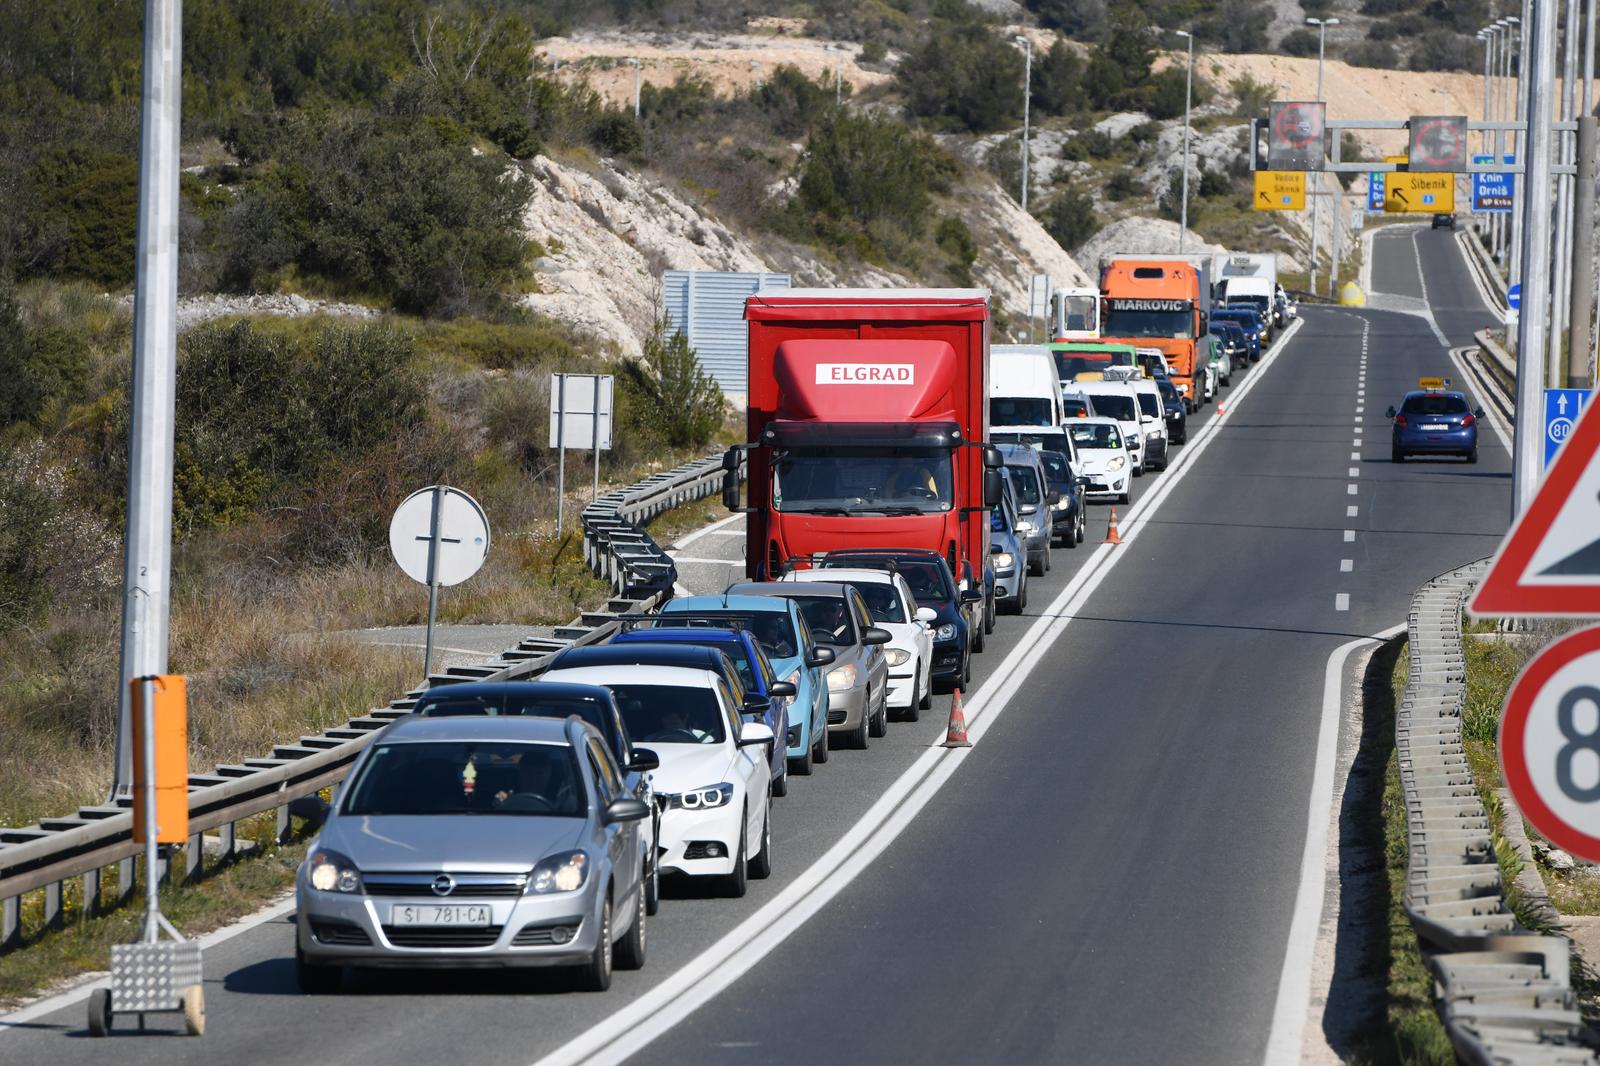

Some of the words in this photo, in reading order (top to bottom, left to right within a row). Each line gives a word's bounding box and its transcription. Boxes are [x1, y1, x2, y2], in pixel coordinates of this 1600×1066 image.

[1479, 173, 1503, 183] Knin
[1114, 299, 1183, 311] MARKOVIC
[831, 367, 910, 381] ELGRAD
[1553, 424, 1570, 438] 80
[1556, 684, 1600, 804] 8
[404, 907, 421, 922] SI
